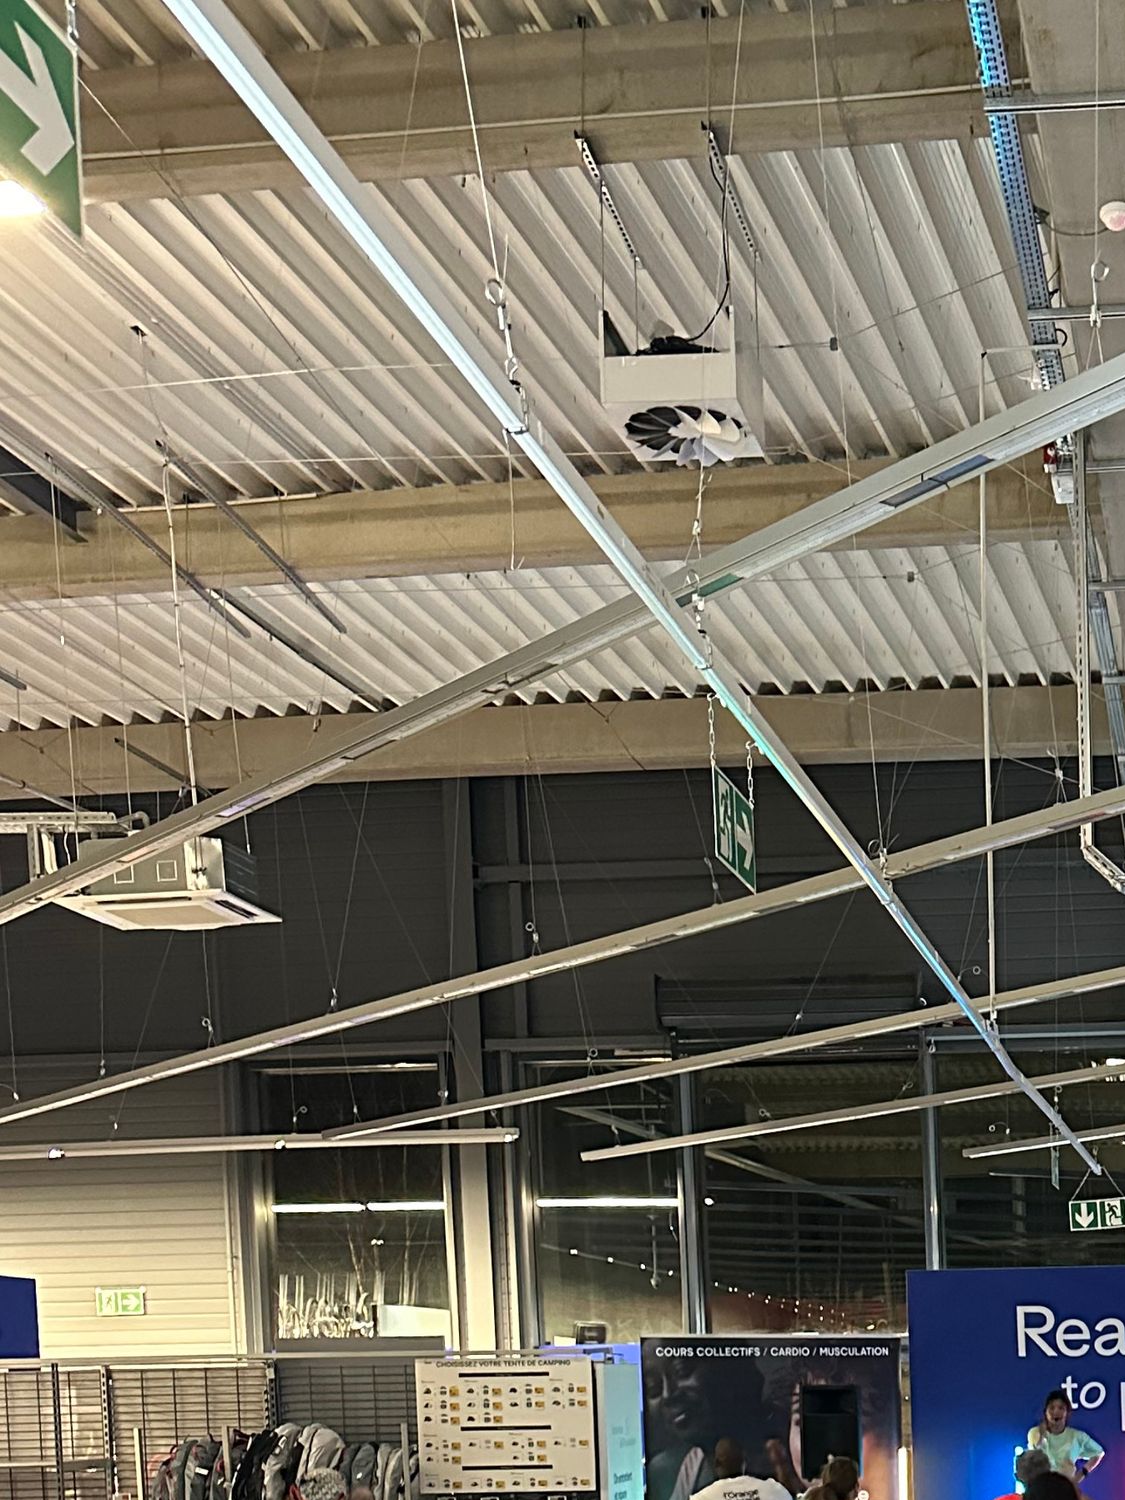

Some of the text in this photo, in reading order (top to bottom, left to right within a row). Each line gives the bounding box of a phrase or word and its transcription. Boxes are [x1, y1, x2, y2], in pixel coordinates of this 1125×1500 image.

[655, 1346, 694, 1357] COURS
[696, 1346, 761, 1357] COLLECTIFS
[770, 1347, 810, 1357] CARDIO
[819, 1346, 889, 1357] MUSCULATION
[478, 1360, 502, 1368] VOTRE
[527, 1359, 536, 1367] DE
[538, 1359, 571, 1367] CAMPING
[1061, 1375, 1106, 1410] to
